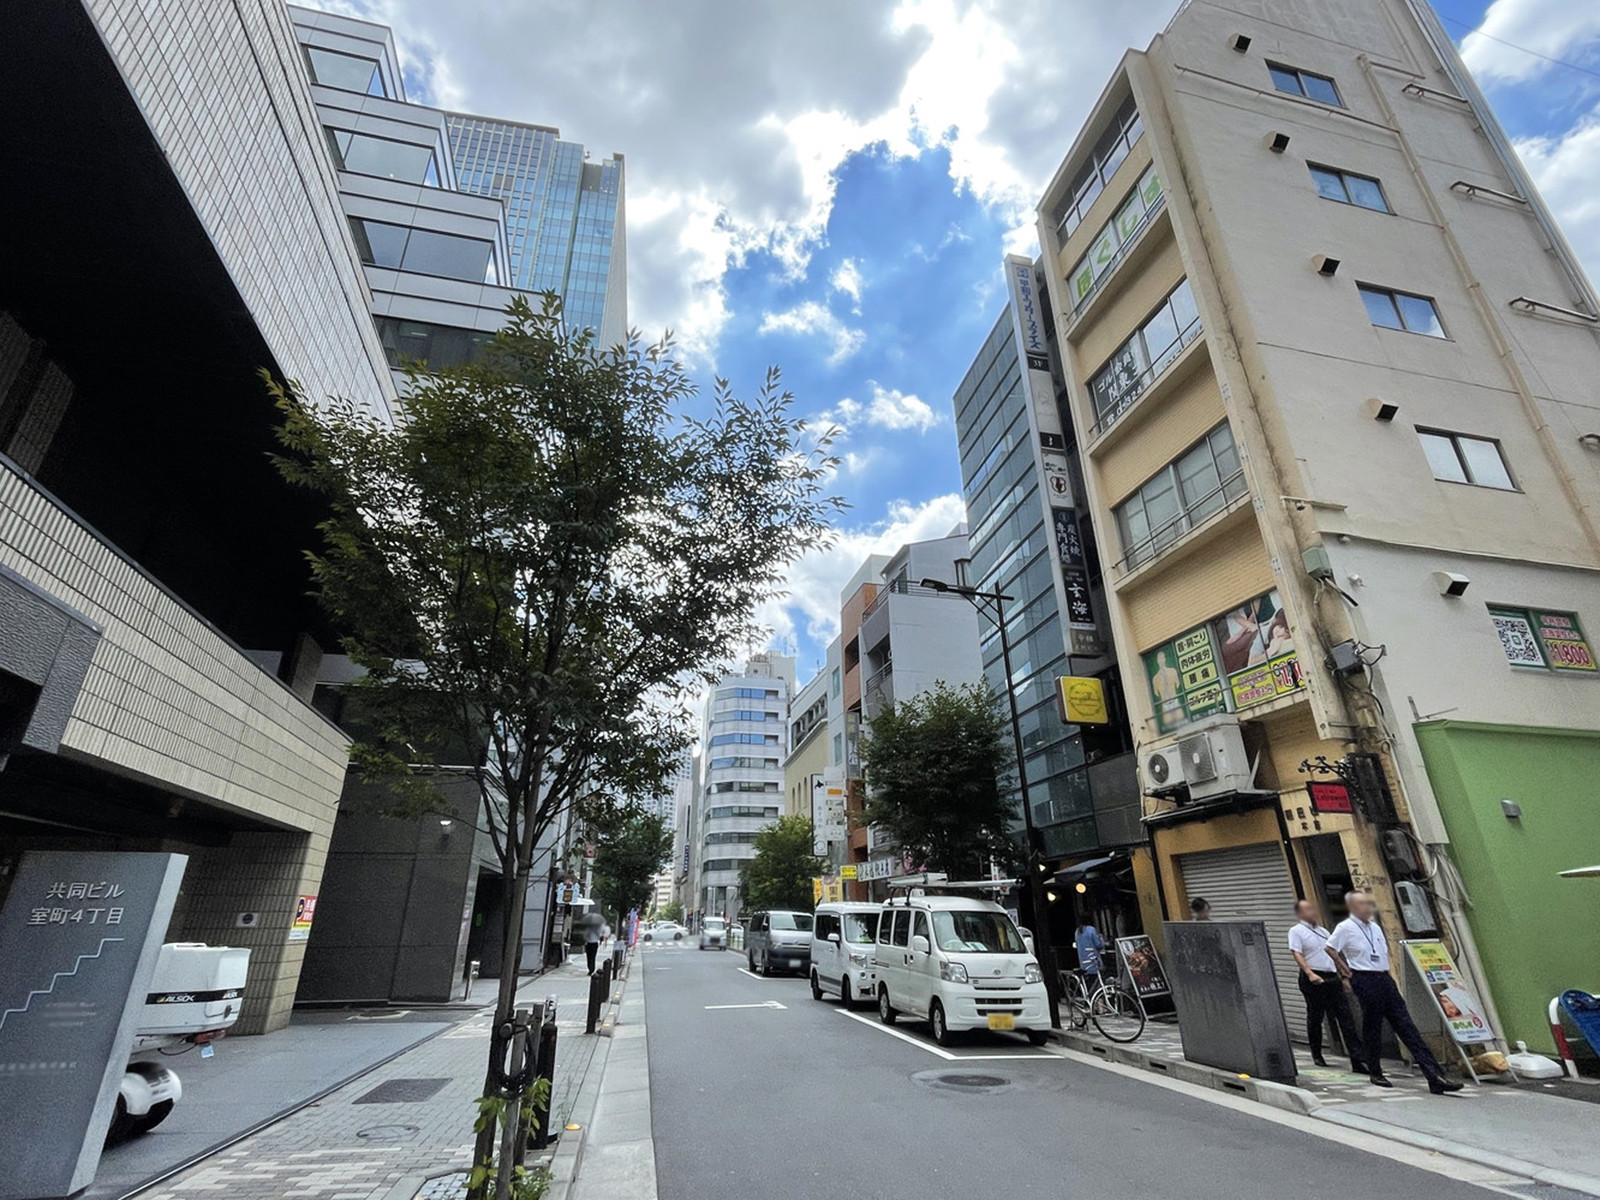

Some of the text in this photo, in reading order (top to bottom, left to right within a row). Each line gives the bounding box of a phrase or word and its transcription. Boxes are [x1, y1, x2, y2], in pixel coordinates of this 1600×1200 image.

[46, 881, 125, 899] 共同ビル
[27, 907, 124, 925] 室町4丁目
